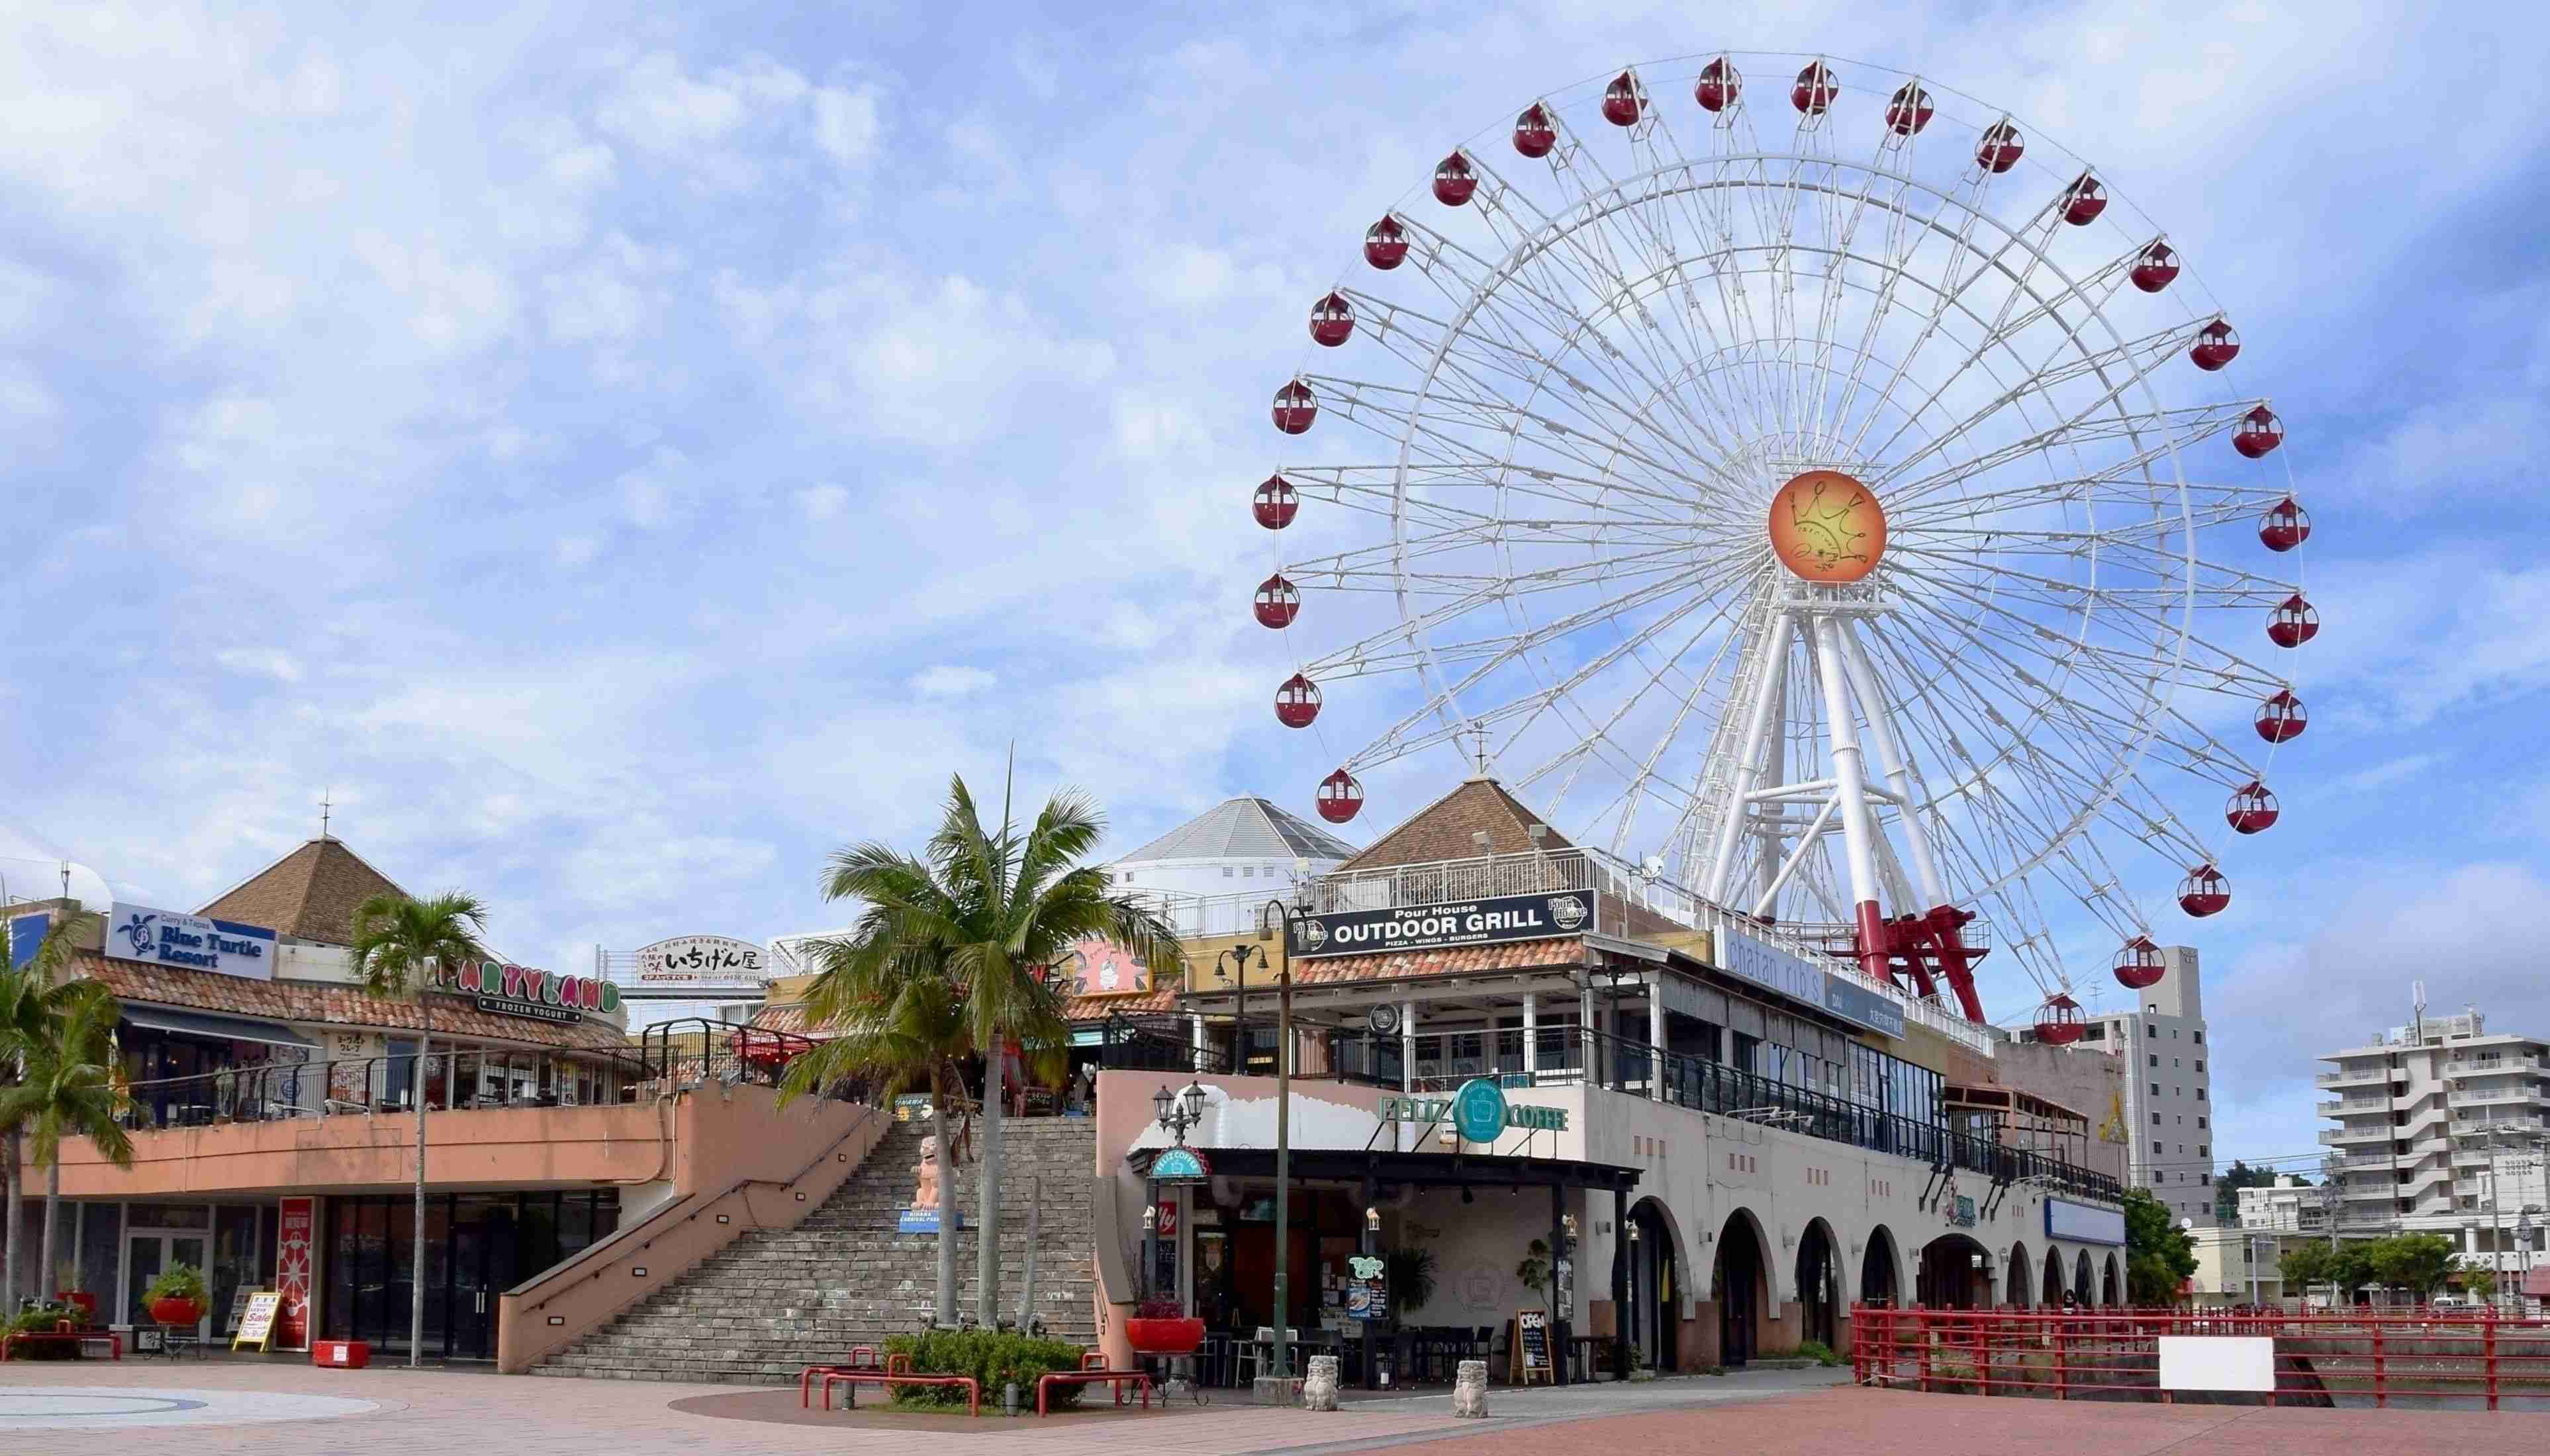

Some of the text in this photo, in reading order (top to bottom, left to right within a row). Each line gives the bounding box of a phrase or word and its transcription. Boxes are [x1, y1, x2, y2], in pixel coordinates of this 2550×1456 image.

[1395, 904, 1478, 919] Pour House
[161, 915, 180, 925] Curry
[188, 919, 210, 929] Tapas
[1335, 909, 1543, 942] OUTDOOR GRILL
[161, 926, 261, 957] Blue Turtle
[1449, 933, 1488, 942] BURGERS
[158, 943, 218, 968] Resort
[665, 946, 763, 970] いちげん屋
[1729, 936, 1819, 1002] chatan rib's
[496, 1003, 567, 1020] FROZEN YOGURT
[1379, 1096, 1569, 1132] FELIZ COFFEE
[1174, 1152, 1198, 1171] COFFEE
[247, 1312, 271, 1322] Sale
[1521, 1312, 1545, 1328] OPEN
